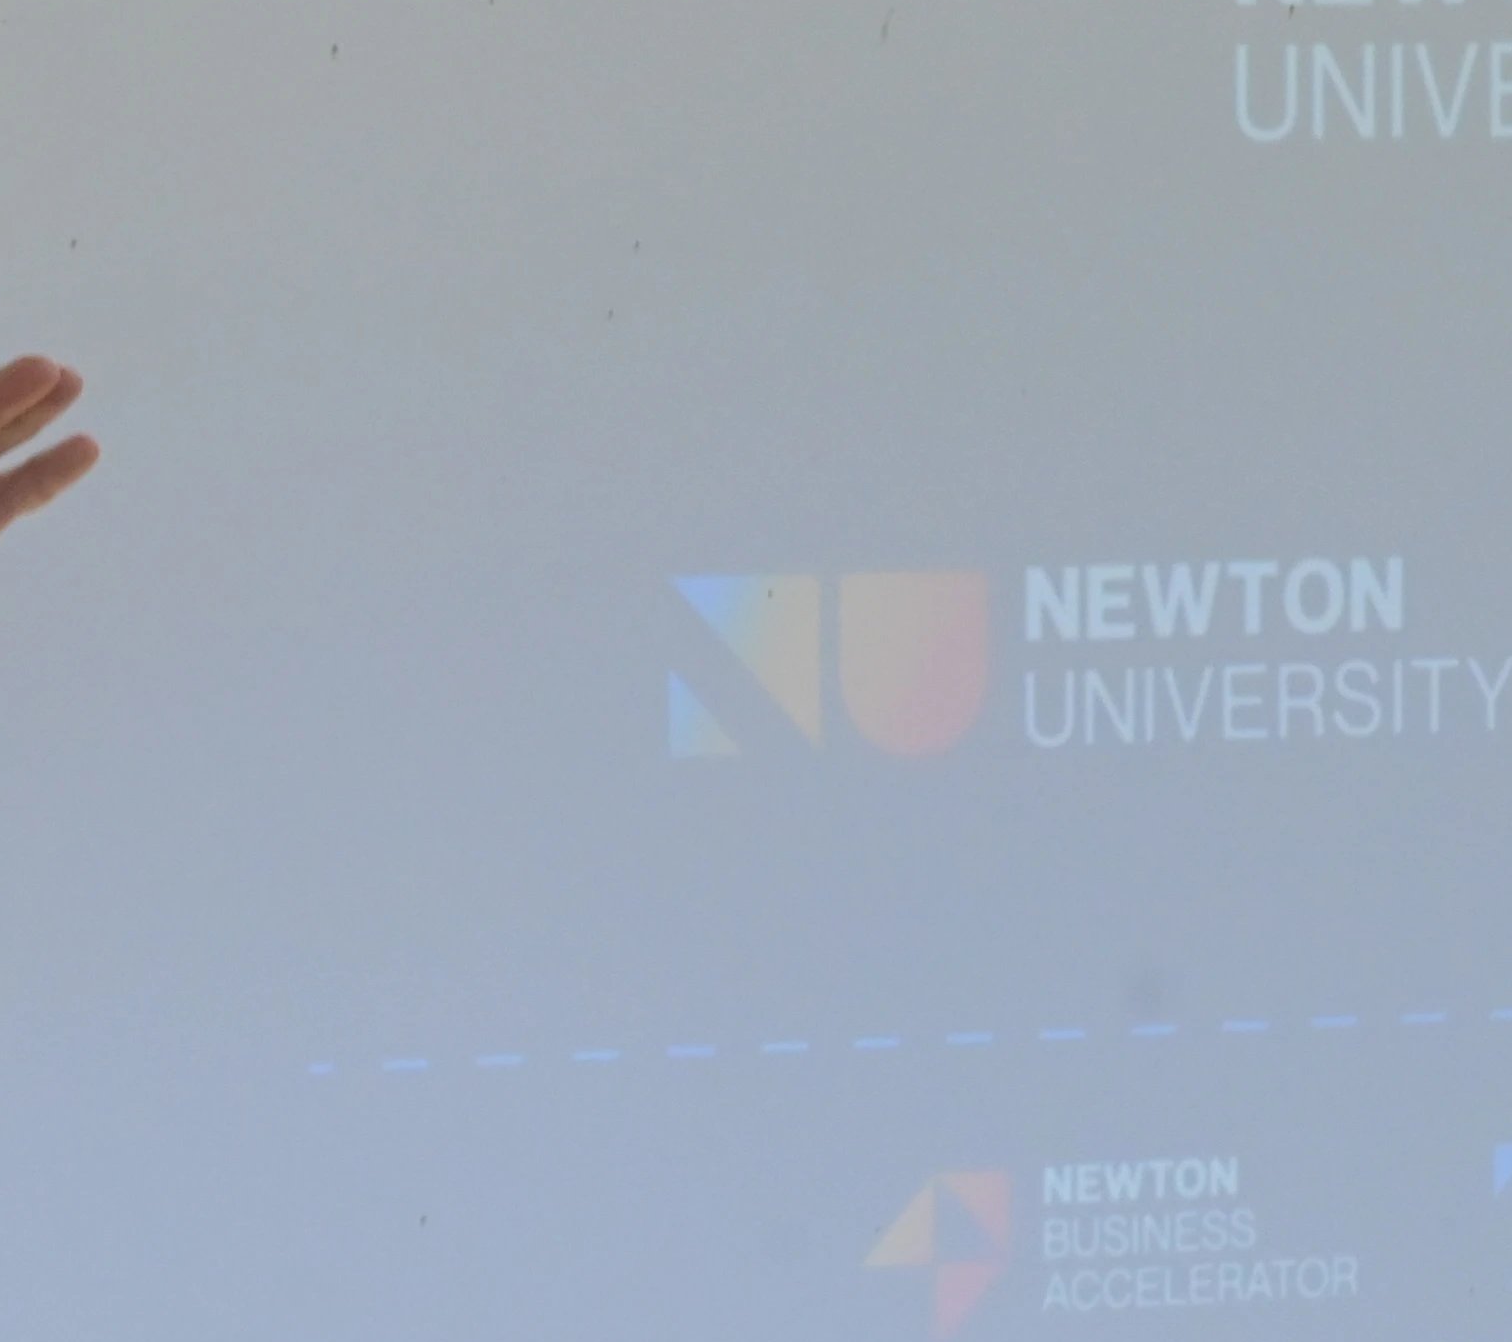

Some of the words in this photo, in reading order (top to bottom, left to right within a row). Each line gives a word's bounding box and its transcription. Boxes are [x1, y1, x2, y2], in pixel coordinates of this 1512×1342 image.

[1024, 556, 1404, 642] NEWTON
[1042, 1156, 1238, 1204] NEWTON
[1043, 1211, 1257, 1257] BUSINESS
[1042, 1257, 1358, 1312] ACCELERATOR
